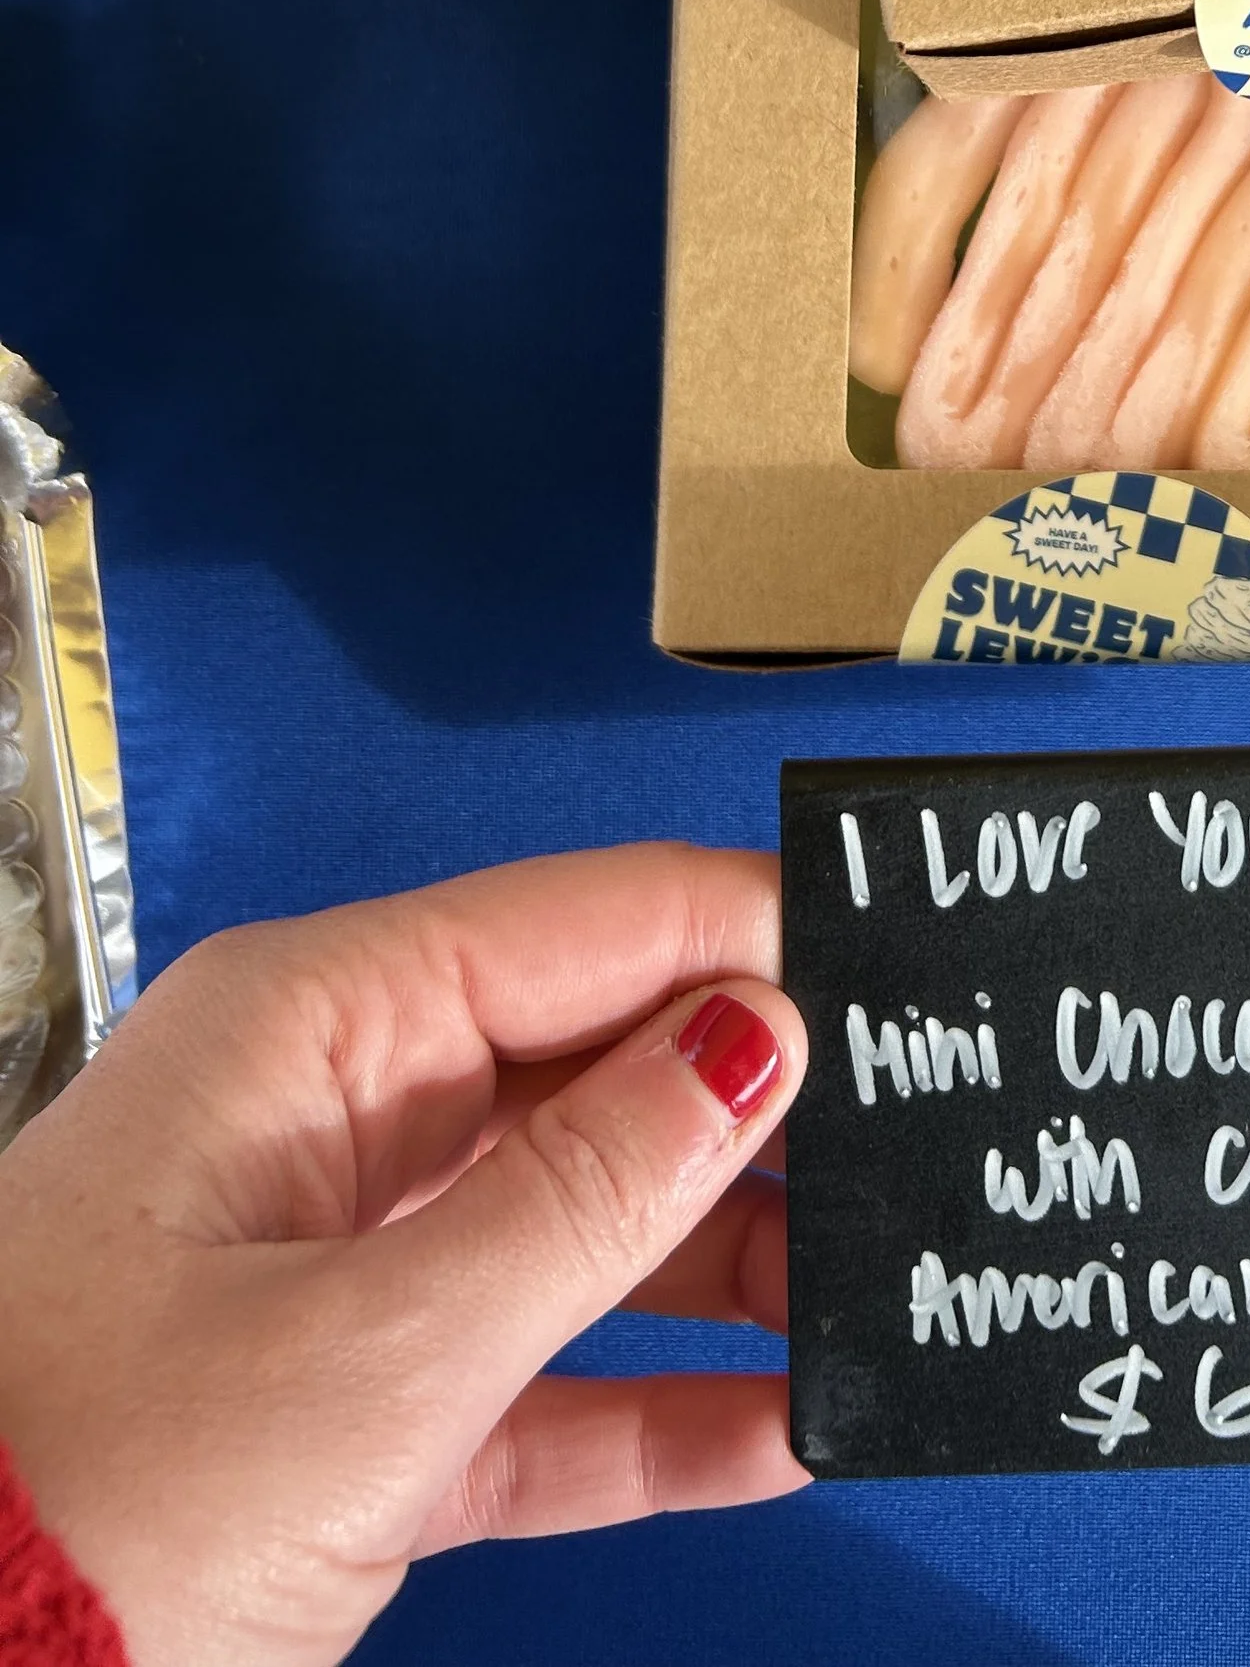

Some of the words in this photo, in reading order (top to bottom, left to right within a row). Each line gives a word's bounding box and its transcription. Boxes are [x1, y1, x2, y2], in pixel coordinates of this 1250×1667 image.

[1034, 536, 1071, 550] SWEET
[1048, 527, 1078, 540] HAVE
[1079, 531, 1088, 542] A
[944, 567, 1175, 659] SWEET
[840, 812, 870, 909] I
[846, 991, 1000, 1106] Mini
